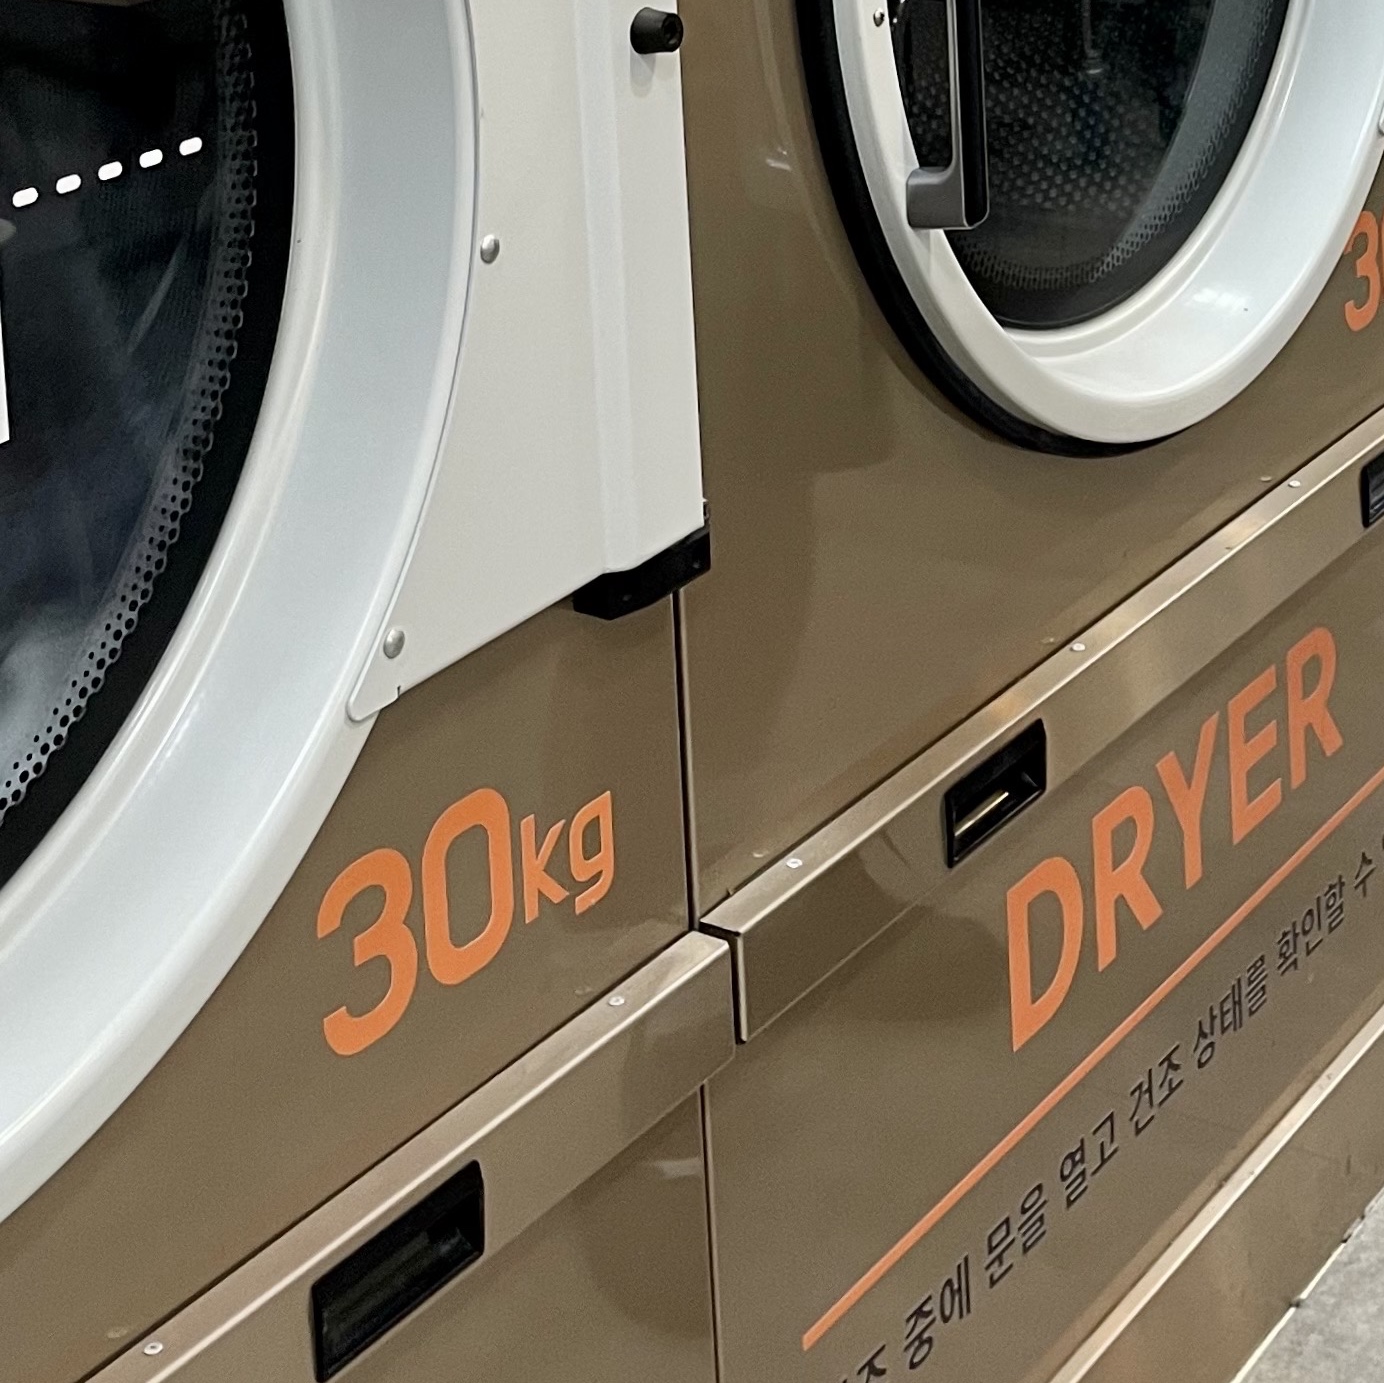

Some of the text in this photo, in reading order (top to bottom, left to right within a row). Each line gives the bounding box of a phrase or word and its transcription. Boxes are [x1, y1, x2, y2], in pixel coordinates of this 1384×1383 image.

[316, 787, 615, 1056] 30kg
[1006, 626, 1344, 1052] DRYER
[904, 1254, 971, 1370] 중에
[985, 1182, 1048, 1289] 문을
[1059, 1111, 1119, 1209] 열고
[1129, 1043, 1184, 1137] 건조
[1193, 953, 1269, 1070] 상태를
[1276, 875, 1346, 977] 확인할
[1353, 851, 1377, 898] 수
